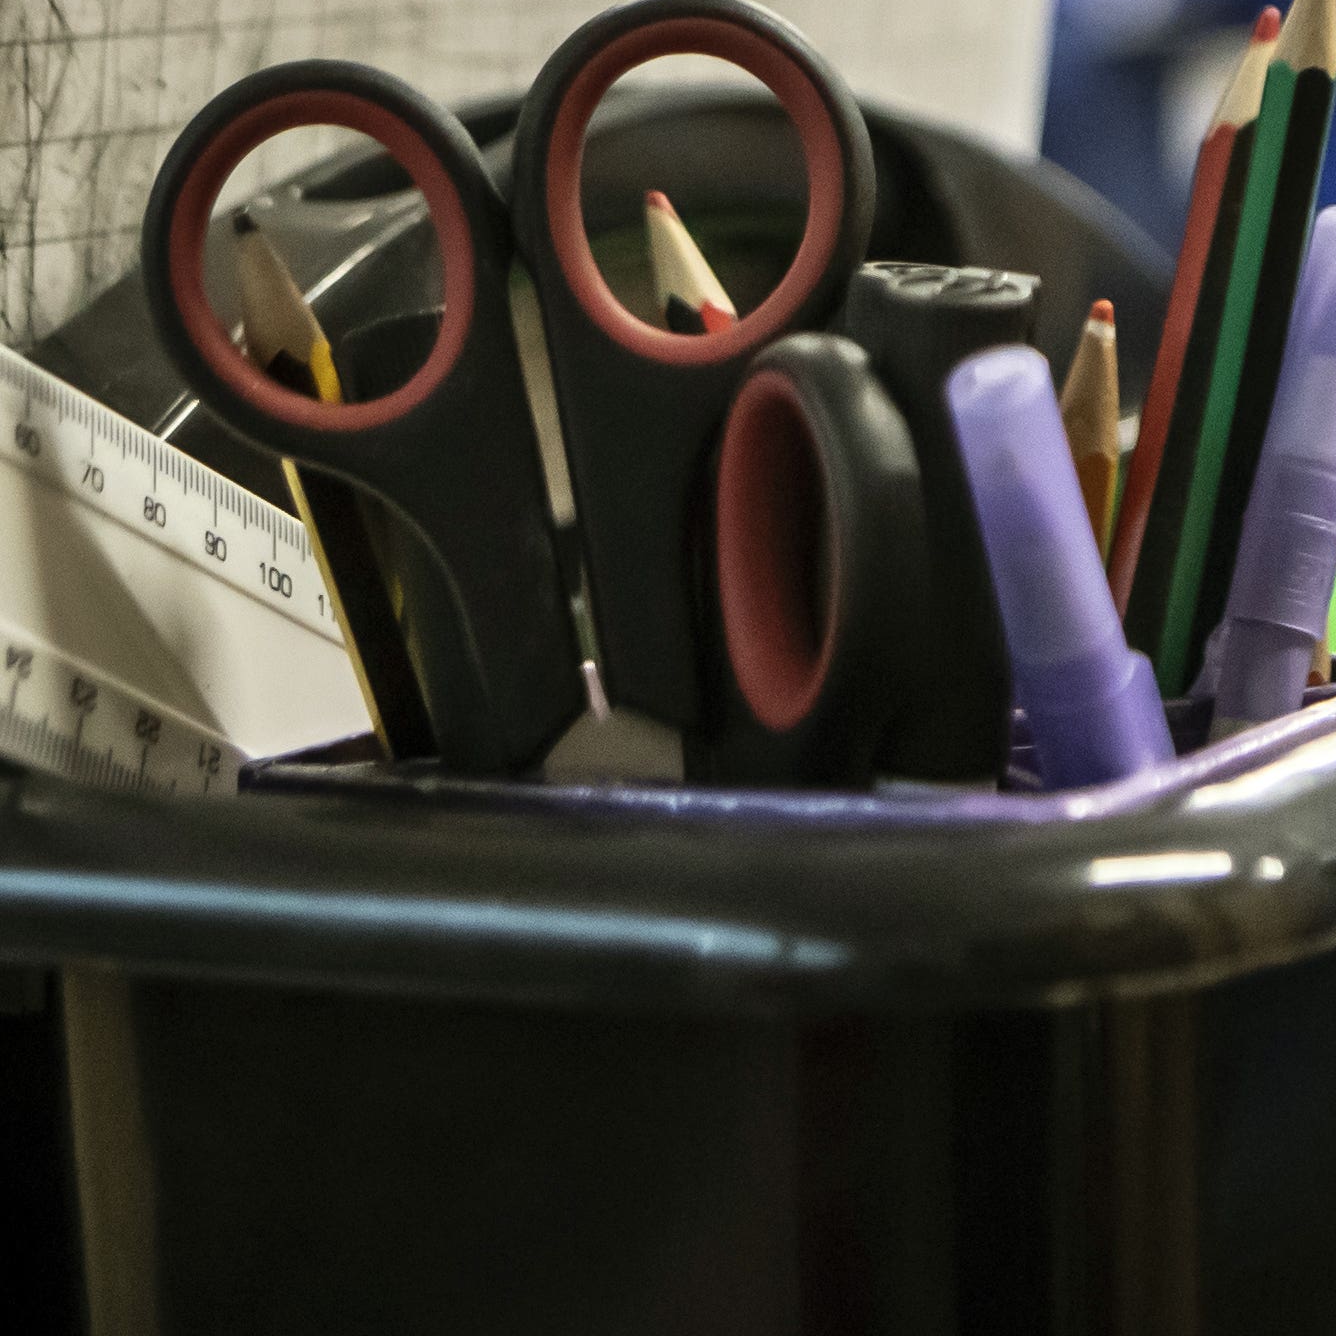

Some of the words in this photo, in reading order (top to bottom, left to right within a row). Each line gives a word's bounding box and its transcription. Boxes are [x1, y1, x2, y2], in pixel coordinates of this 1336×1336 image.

[143, 495, 167, 528] 80
[204, 530, 228, 562] 90
[259, 562, 293, 599] 100
